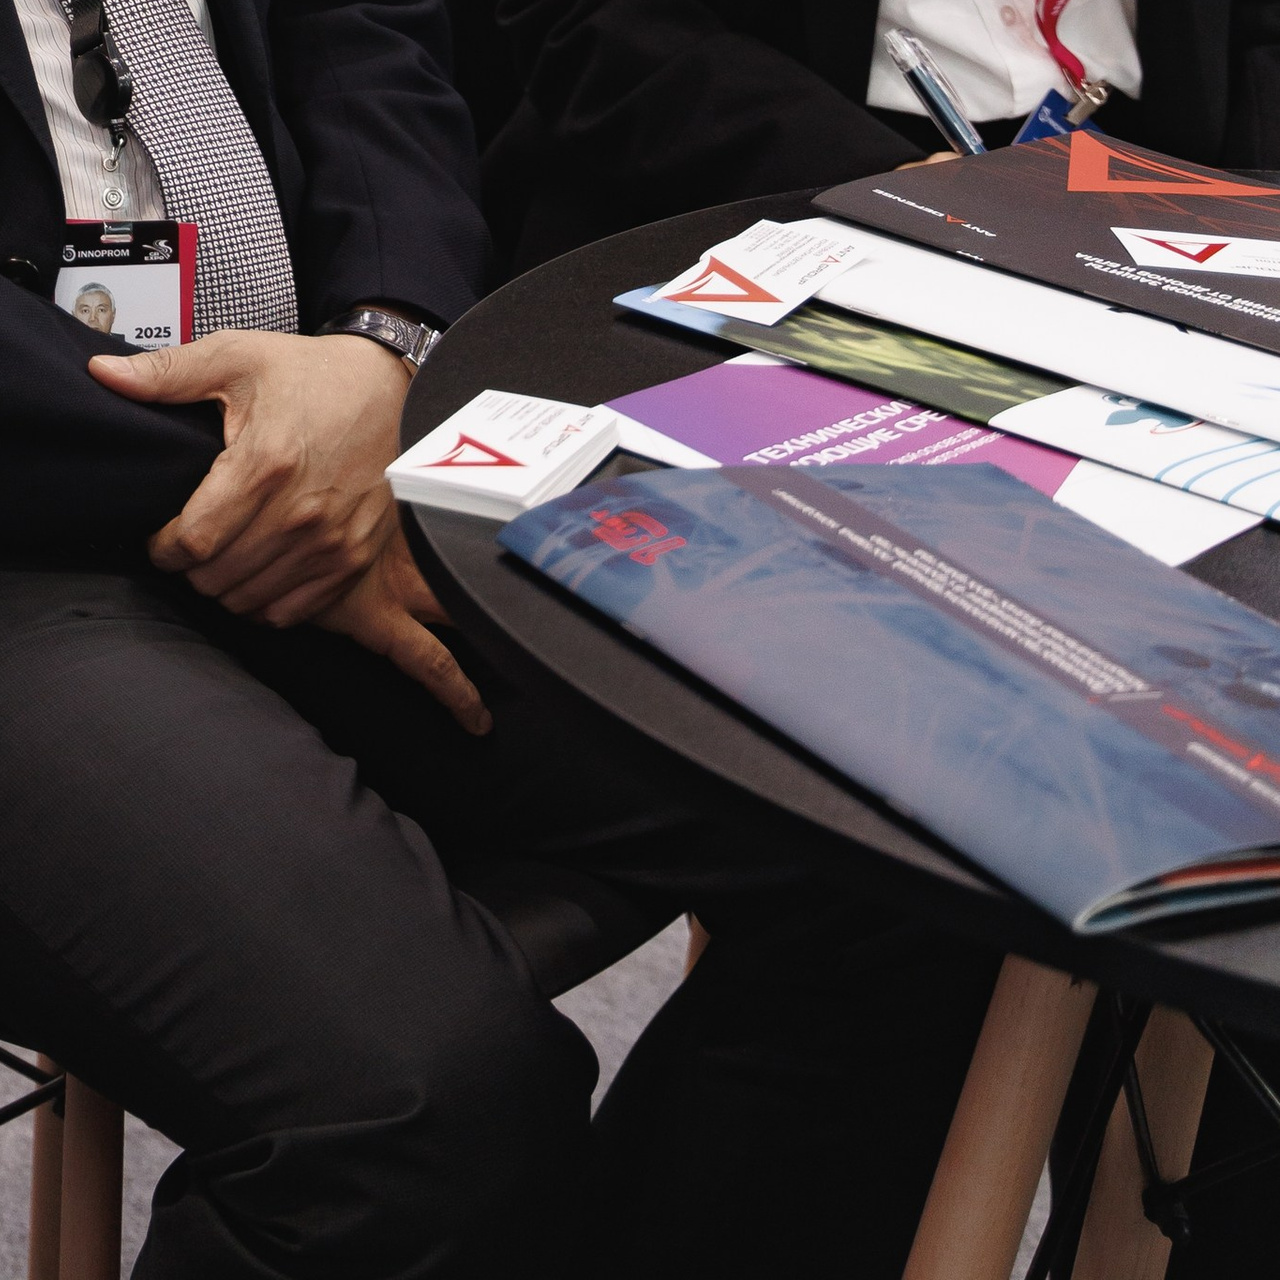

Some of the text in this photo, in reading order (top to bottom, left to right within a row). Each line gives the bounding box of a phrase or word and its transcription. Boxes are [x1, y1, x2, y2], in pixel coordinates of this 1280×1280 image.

[77, 248, 130, 258] INNOPROM
[1075, 251, 1122, 269] БПЛА
[1084, 261, 1163, 287] ЗАЩИТЫ
[1137, 270, 1211, 293] ДРОНОВ
[1207, 290, 1232, 300] ОТ
[134, 326, 172, 339] 2025
